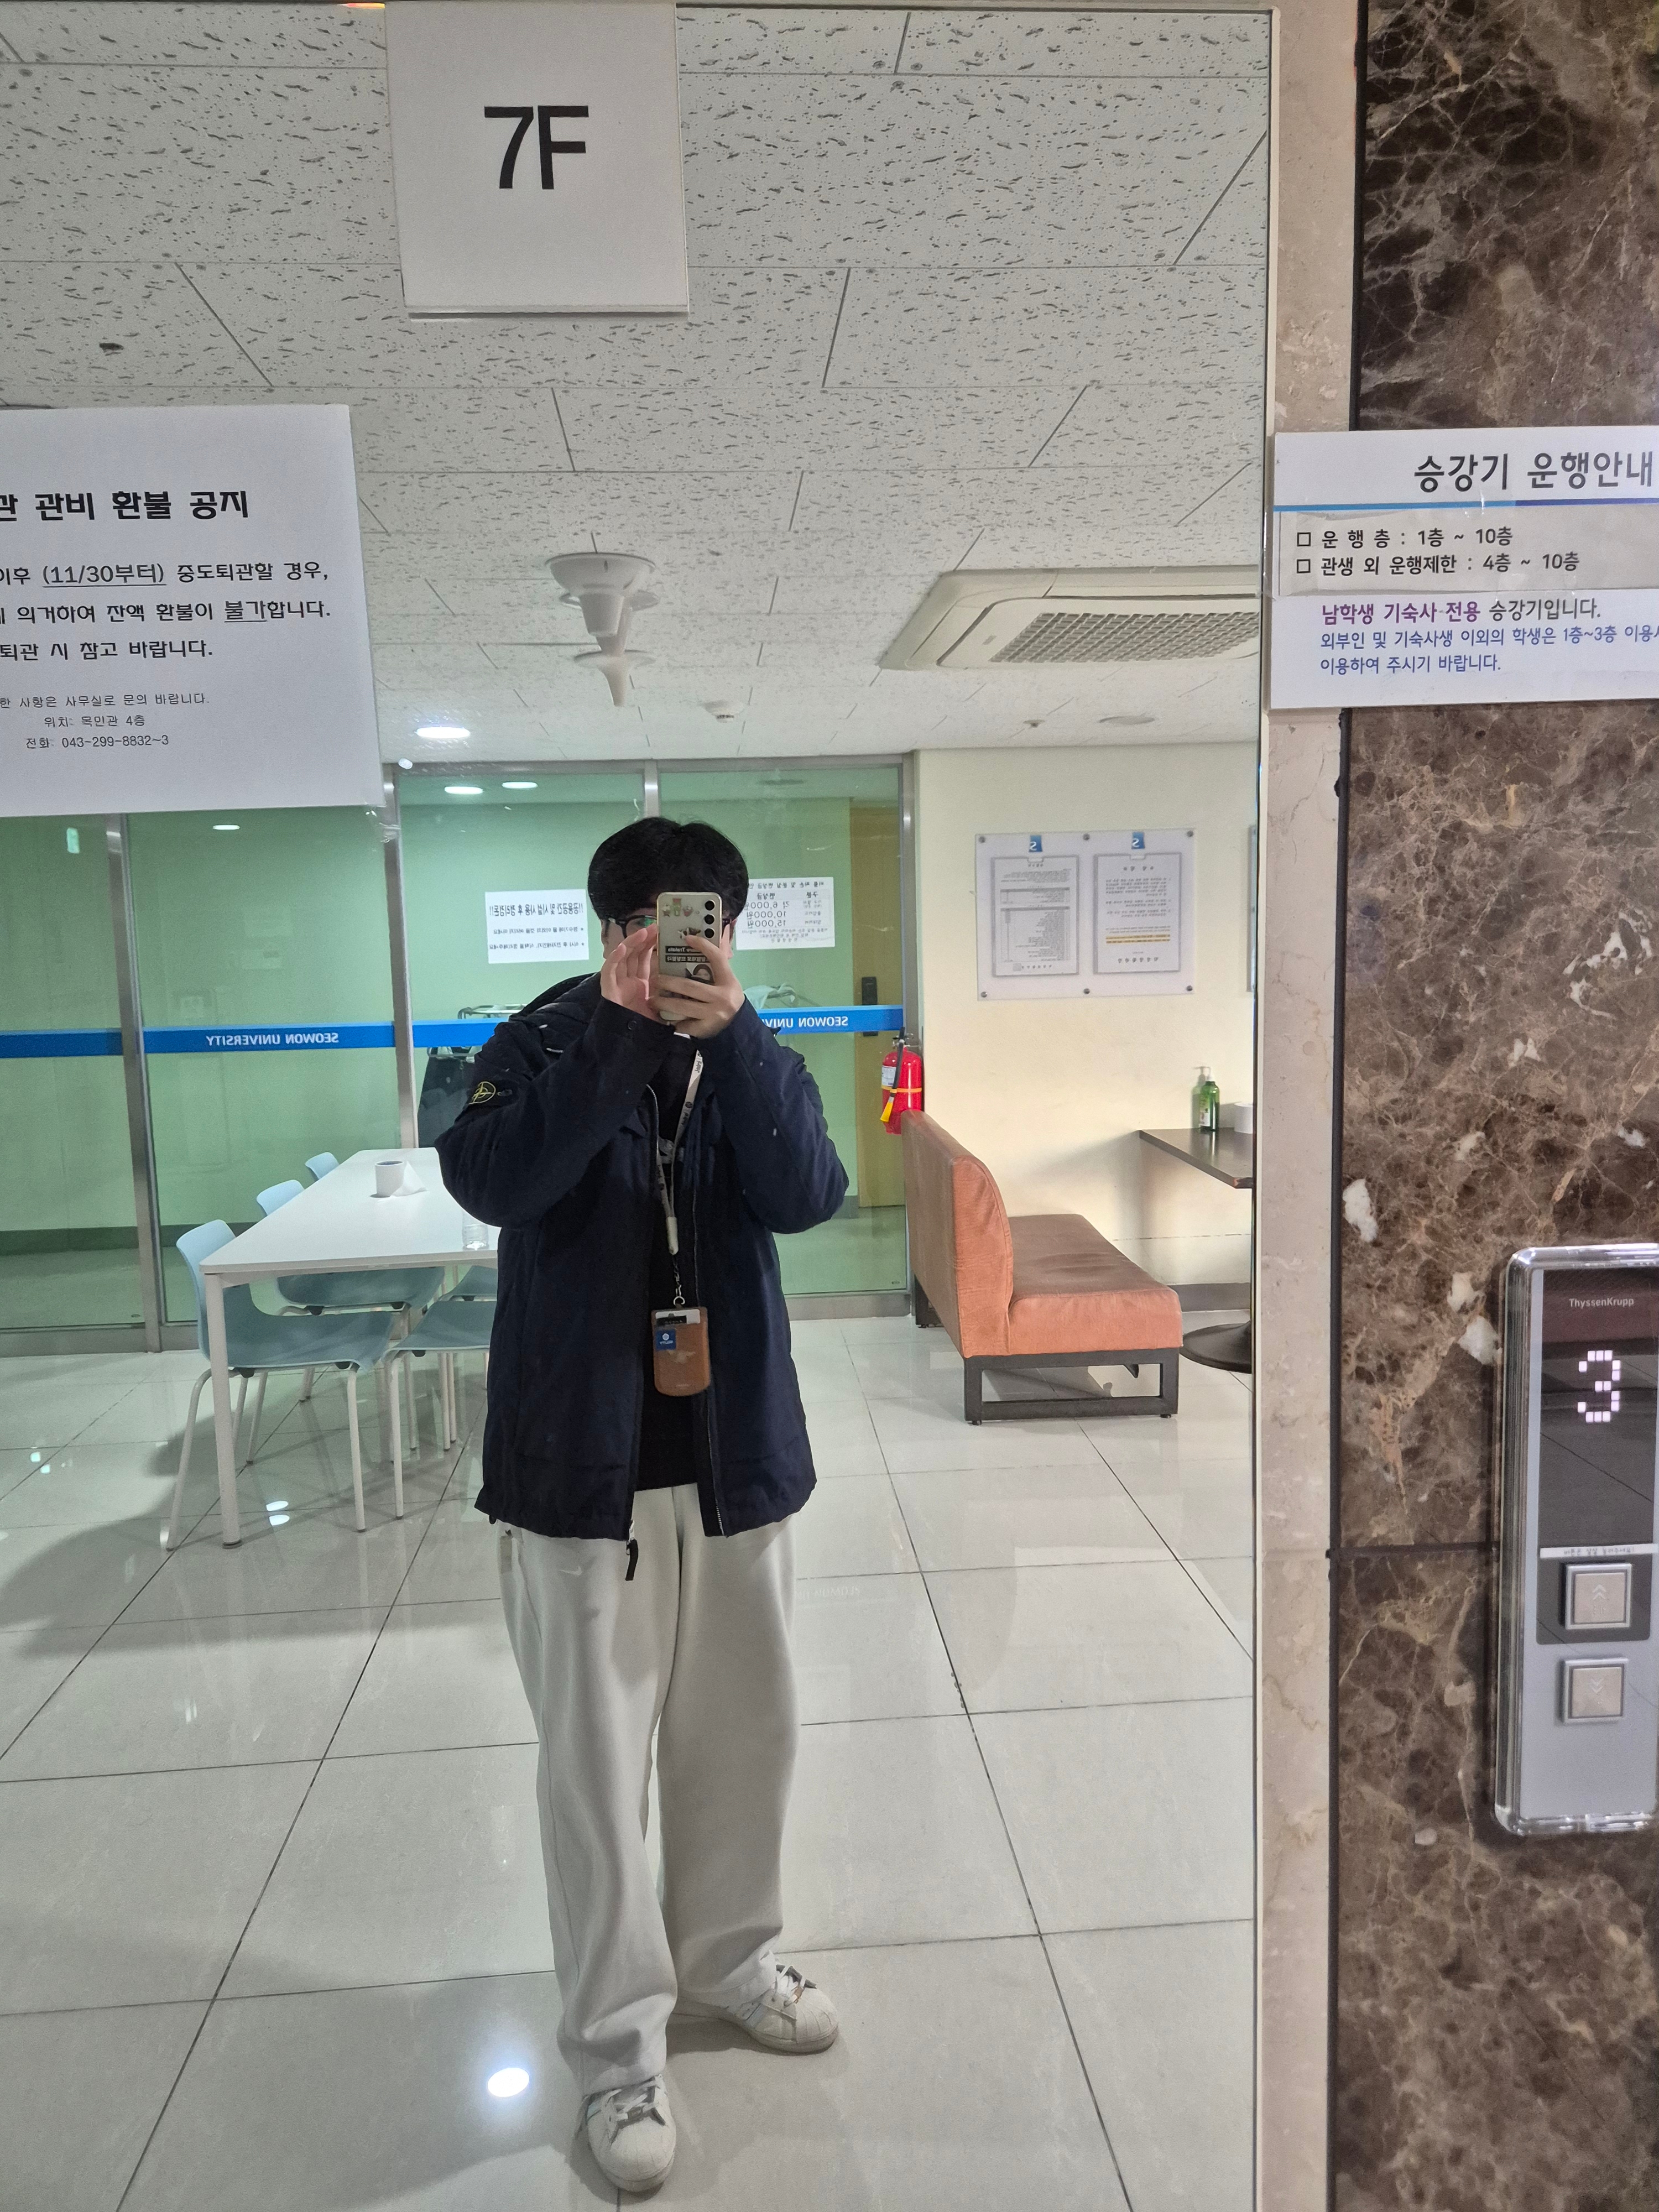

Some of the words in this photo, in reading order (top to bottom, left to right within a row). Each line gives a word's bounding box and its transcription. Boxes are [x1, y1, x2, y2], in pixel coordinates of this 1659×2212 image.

[484, 106, 589, 189] 7F
[1415, 454, 1507, 492] 승강기
[1527, 452, 1652, 489] 운행안내
[35, 493, 95, 520] 관비
[112, 491, 171, 519] 환불
[190, 491, 248, 519] 공지
[1322, 531, 1338, 549] 운
[1348, 530, 1363, 549] 행
[1374, 529, 1390, 548] 층
[1418, 528, 1444, 547] 1층
[1476, 526, 1512, 546] 10층
[43, 564, 165, 585] (11/30부터)
[178, 563, 273, 582] 중도퇴관할
[284, 562, 327, 580] 경우,
[1321, 557, 1353, 576] 관생
[1364, 556, 1379, 575] 외
[1390, 555, 1457, 575] 운행제한
[1483, 553, 1510, 572] 4층
[1543, 552, 1579, 571] 10층
[18, 606, 95, 623] 의거하여
[107, 605, 144, 622] 잔액
[156, 603, 212, 621] 환불이
[225, 601, 330, 620] 불가합니다.
[1323, 604, 1373, 625] 남학생
[1384, 602, 1437, 623] 기숙사
[1446, 602, 1480, 622] 전용
[1489, 598, 1600, 621] 승강기입니다.
[1321, 632, 1364, 650] 외부인
[1373, 632, 1386, 649] 및
[1395, 630, 1452, 648] 기숙사생
[1461, 629, 1504, 646] 이외의
[1512, 628, 1556, 645] 학생은
[1564, 625, 1617, 644] 1층~3층
[0, 644, 38, 661] 퇴관
[51, 643, 67, 660] 시
[80, 643, 118, 660] 참고
[129, 640, 212, 658] 바랍니다.
[1321, 657, 1379, 675] 이용하여
[1387, 656, 1430, 674] 주시기
[1439, 654, 1500, 672] 바랍니다.
[20, 697, 56, 708] 사항은
[66, 696, 115, 706] 사무실로
[124, 695, 147, 705] 문의
[155, 693, 210, 705] 바랍니다.
[82, 716, 118, 727] 목민관
[126, 715, 144, 726] 4층
[62, 735, 168, 748] 043-299-8832~3
[1569, 1297, 1634, 1309] ThyssenKrupp
[1577, 1350, 1621, 1423] 3
